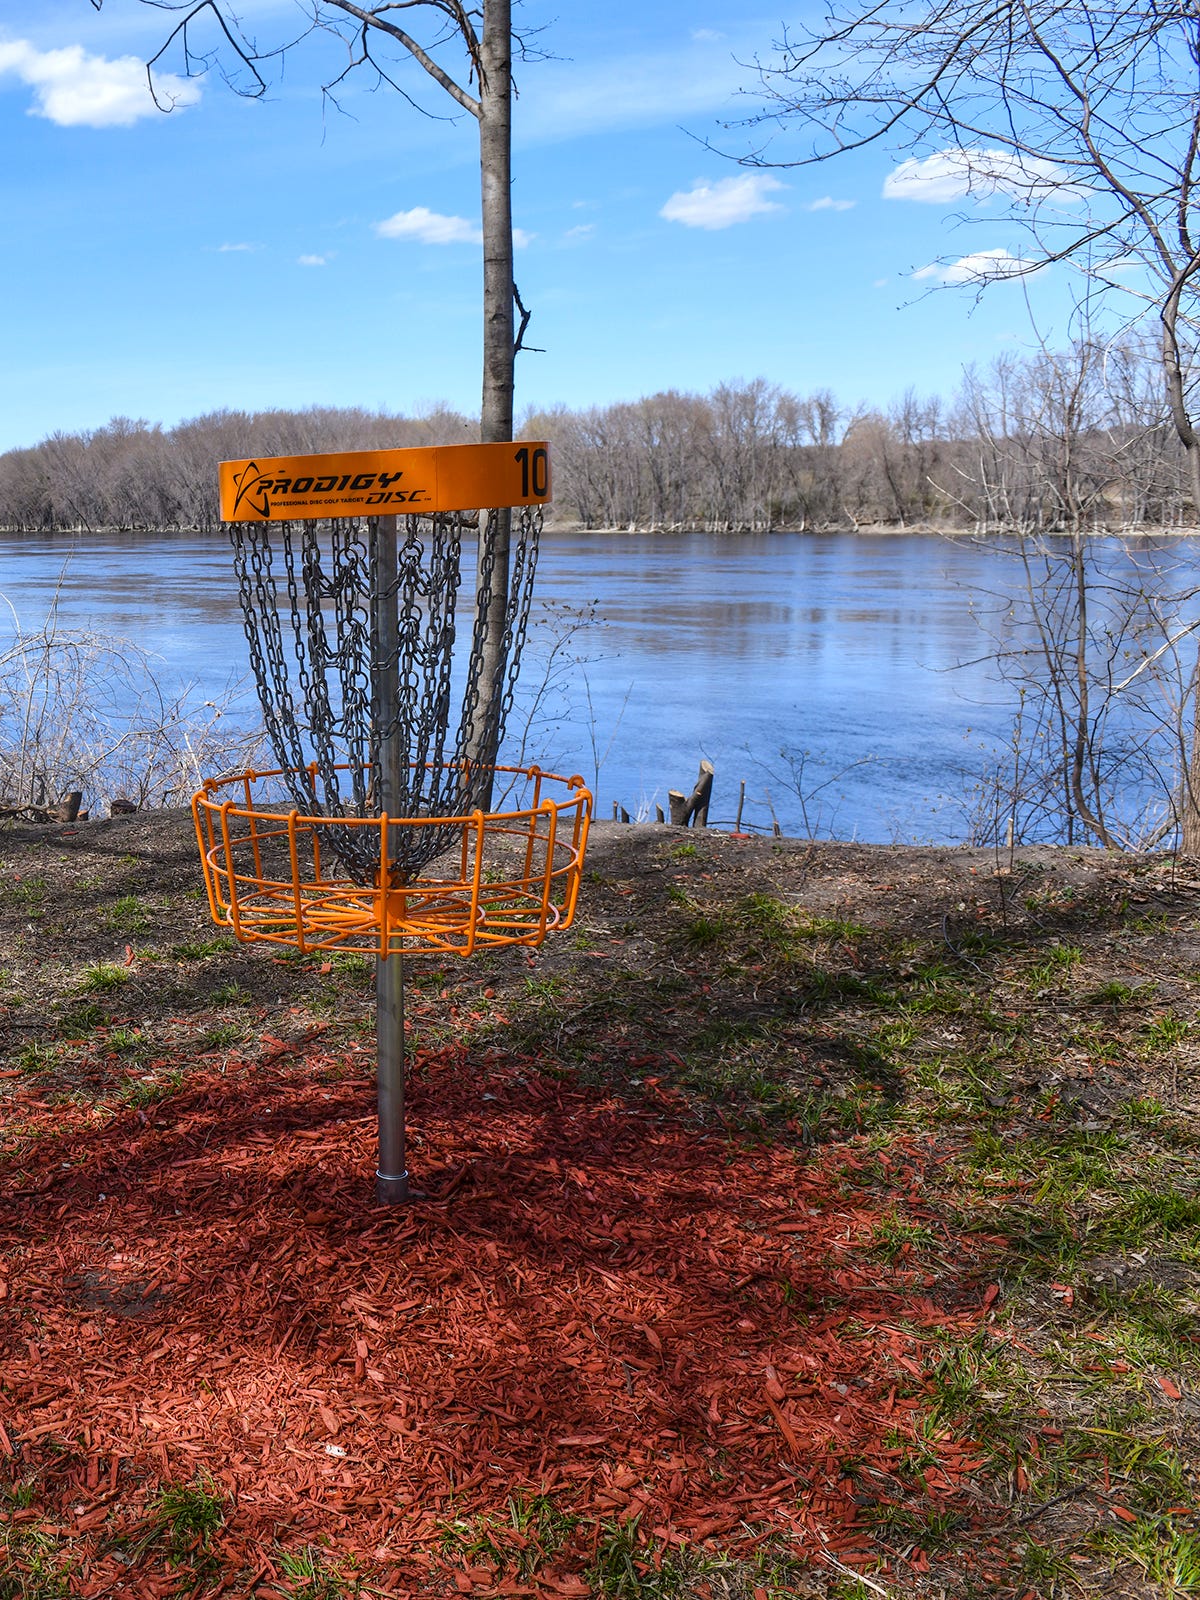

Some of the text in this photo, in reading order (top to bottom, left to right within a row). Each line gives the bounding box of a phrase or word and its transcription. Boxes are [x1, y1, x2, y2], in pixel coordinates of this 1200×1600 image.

[515, 448, 548, 497] 10
[257, 472, 403, 495] PRODIGY
[270, 499, 308, 507] PROFESSIONAL
[365, 490, 426, 505] DISC
